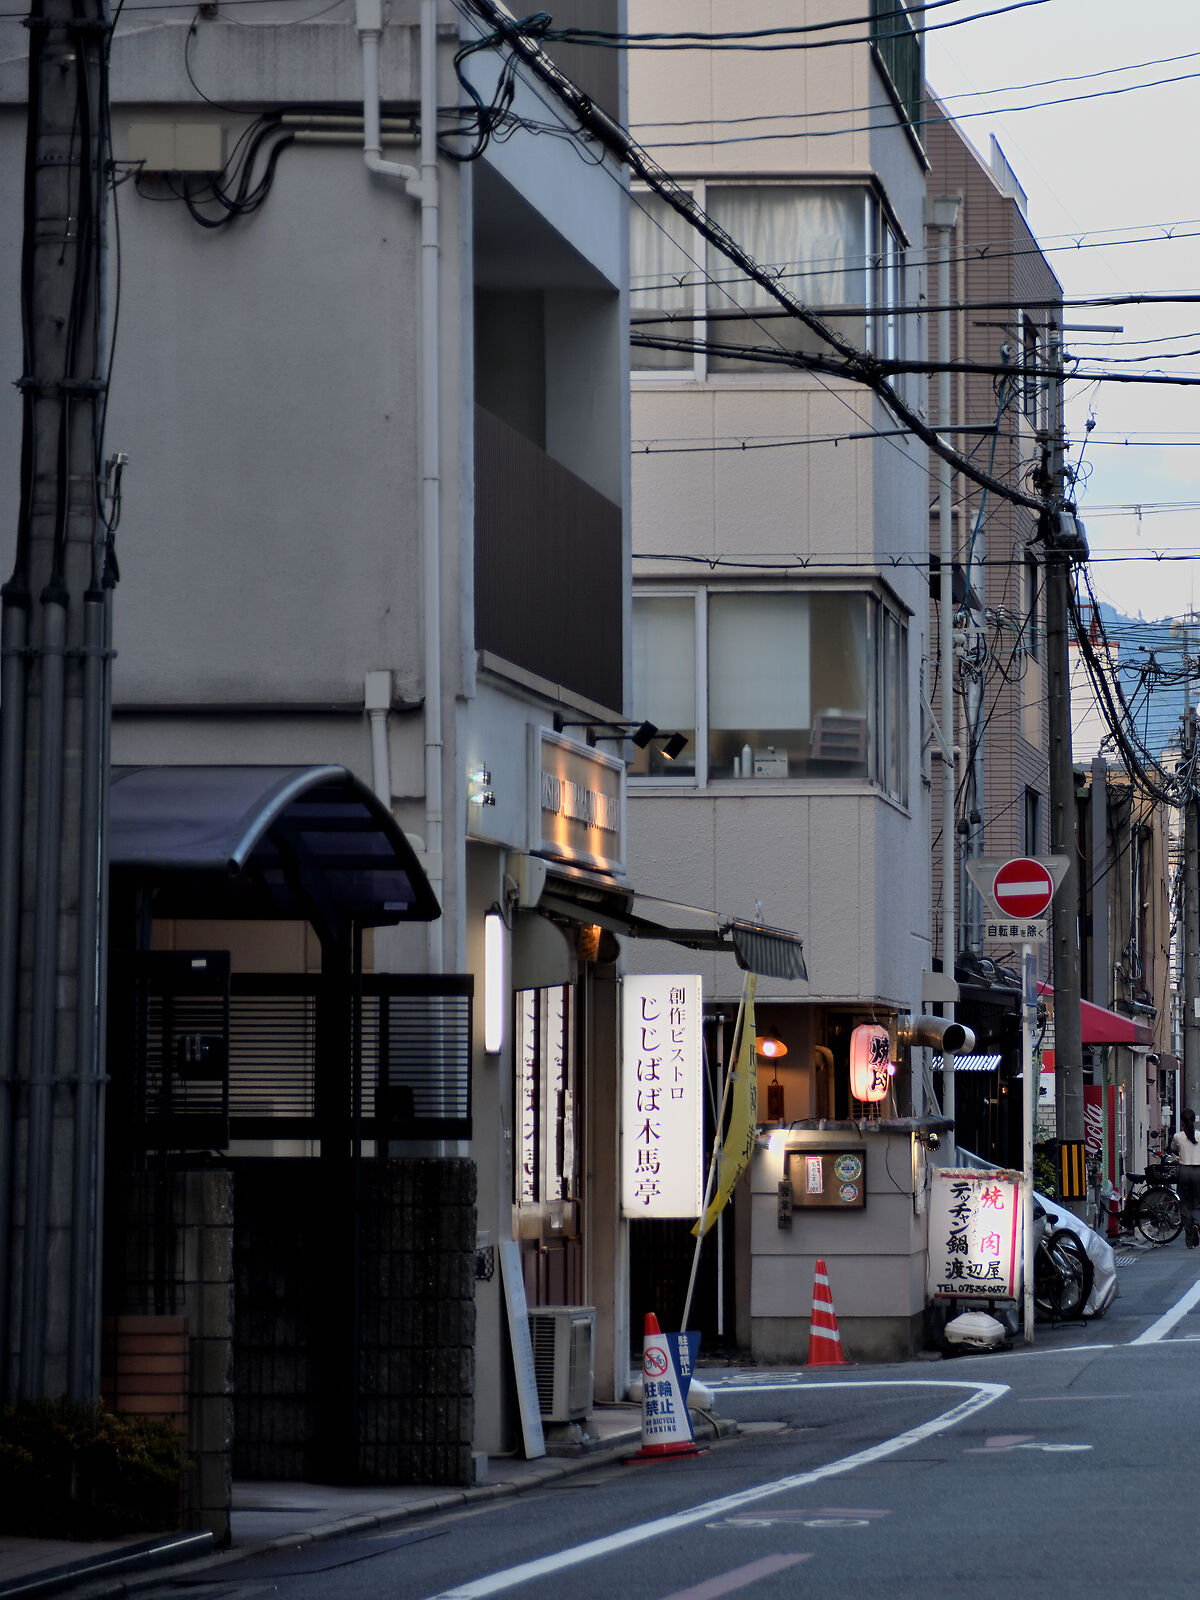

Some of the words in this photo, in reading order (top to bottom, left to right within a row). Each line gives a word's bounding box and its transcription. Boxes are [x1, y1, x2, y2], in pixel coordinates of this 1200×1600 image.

[988, 925, 1044, 938] 自転車を除く
[669, 987, 686, 1100] 創作ビストロ
[870, 1036, 889, 1092] 焼肉
[634, 996, 663, 1206] じじばば木馬亭
[946, 1182, 972, 1255] テッチャン鍋
[981, 1186, 1004, 1256] 焼肉
[945, 1257, 1005, 1281] 渡辺屋
[937, 1284, 957, 1294] TEL
[677, 1335, 691, 1376] 駐輪禁止
[644, 1381, 673, 1398] 駐輪
[645, 1400, 675, 1417] 禁止
[653, 1416, 676, 1425] BICYCLE
[646, 1425, 677, 1434] PARKING
